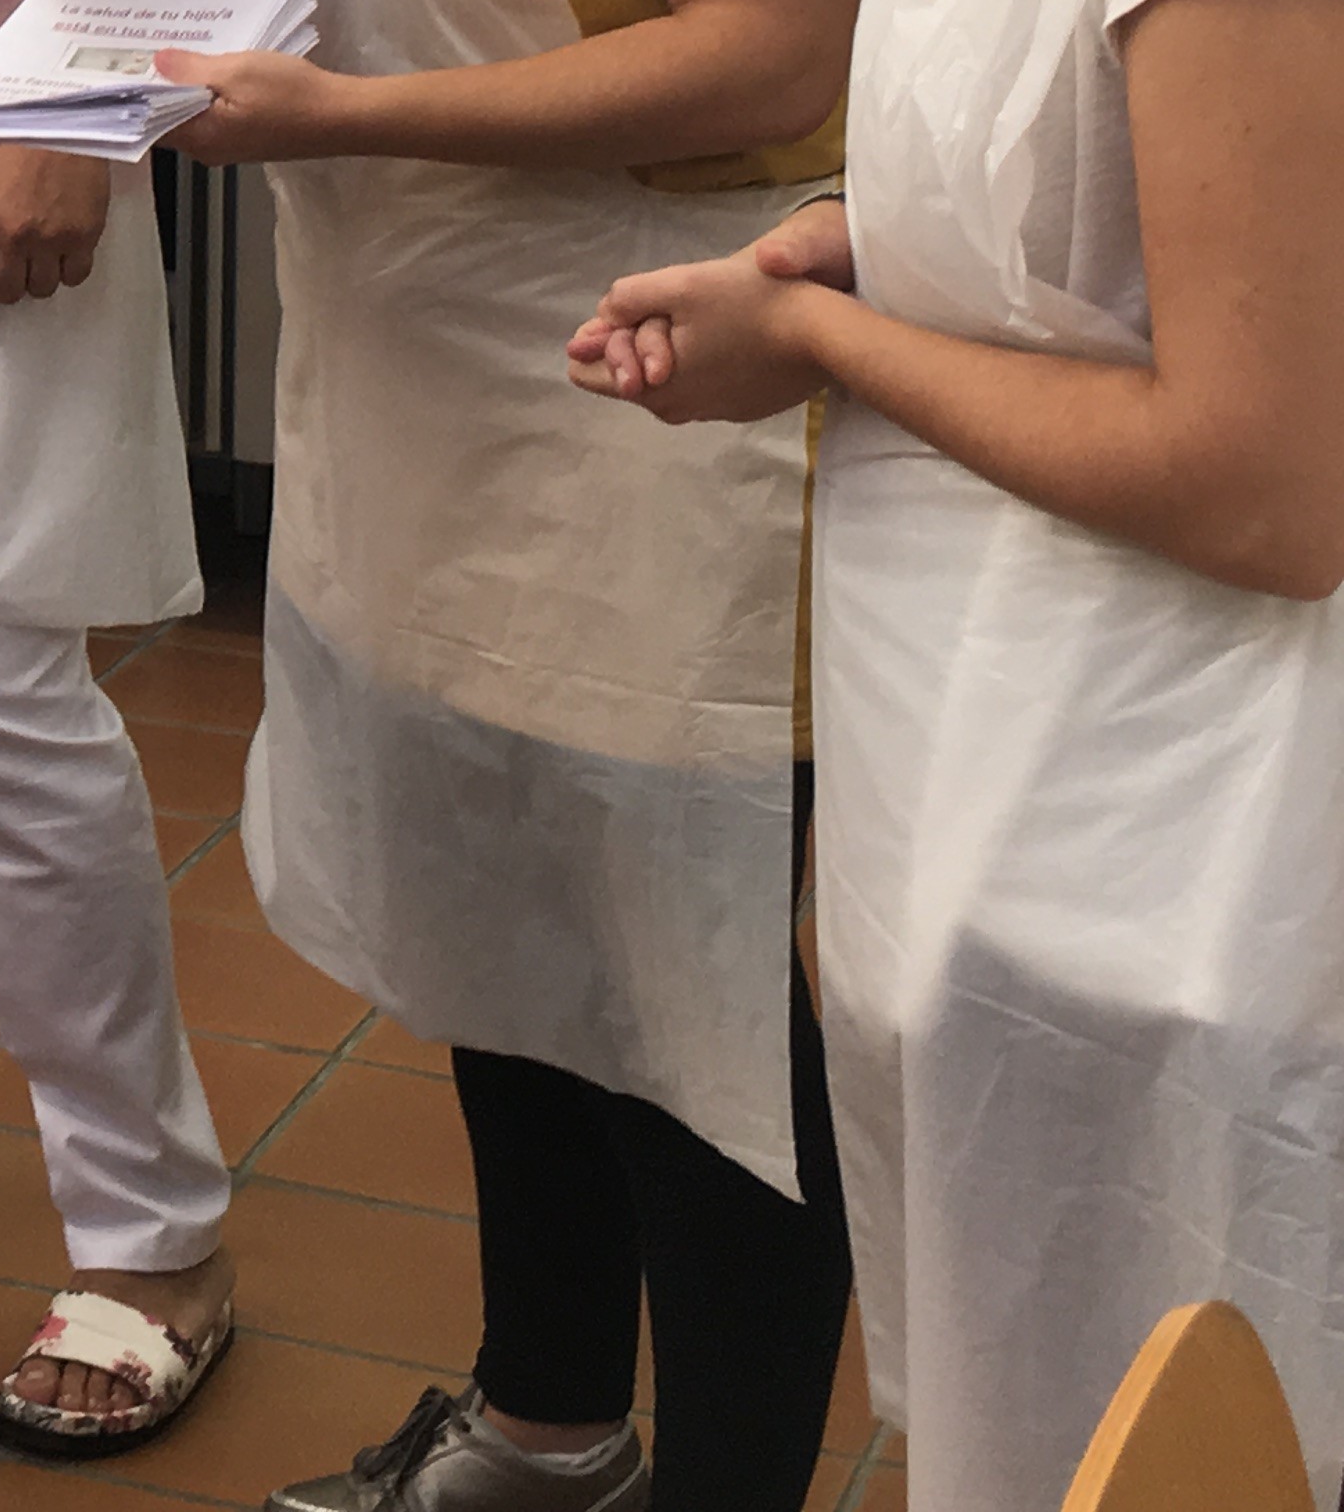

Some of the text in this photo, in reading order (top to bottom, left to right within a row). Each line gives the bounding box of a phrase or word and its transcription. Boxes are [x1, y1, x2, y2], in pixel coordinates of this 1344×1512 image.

[61, 4, 234, 23] La salud de tu hijo/a
[93, 25, 116, 37] en
[121, 26, 147, 38] tus
